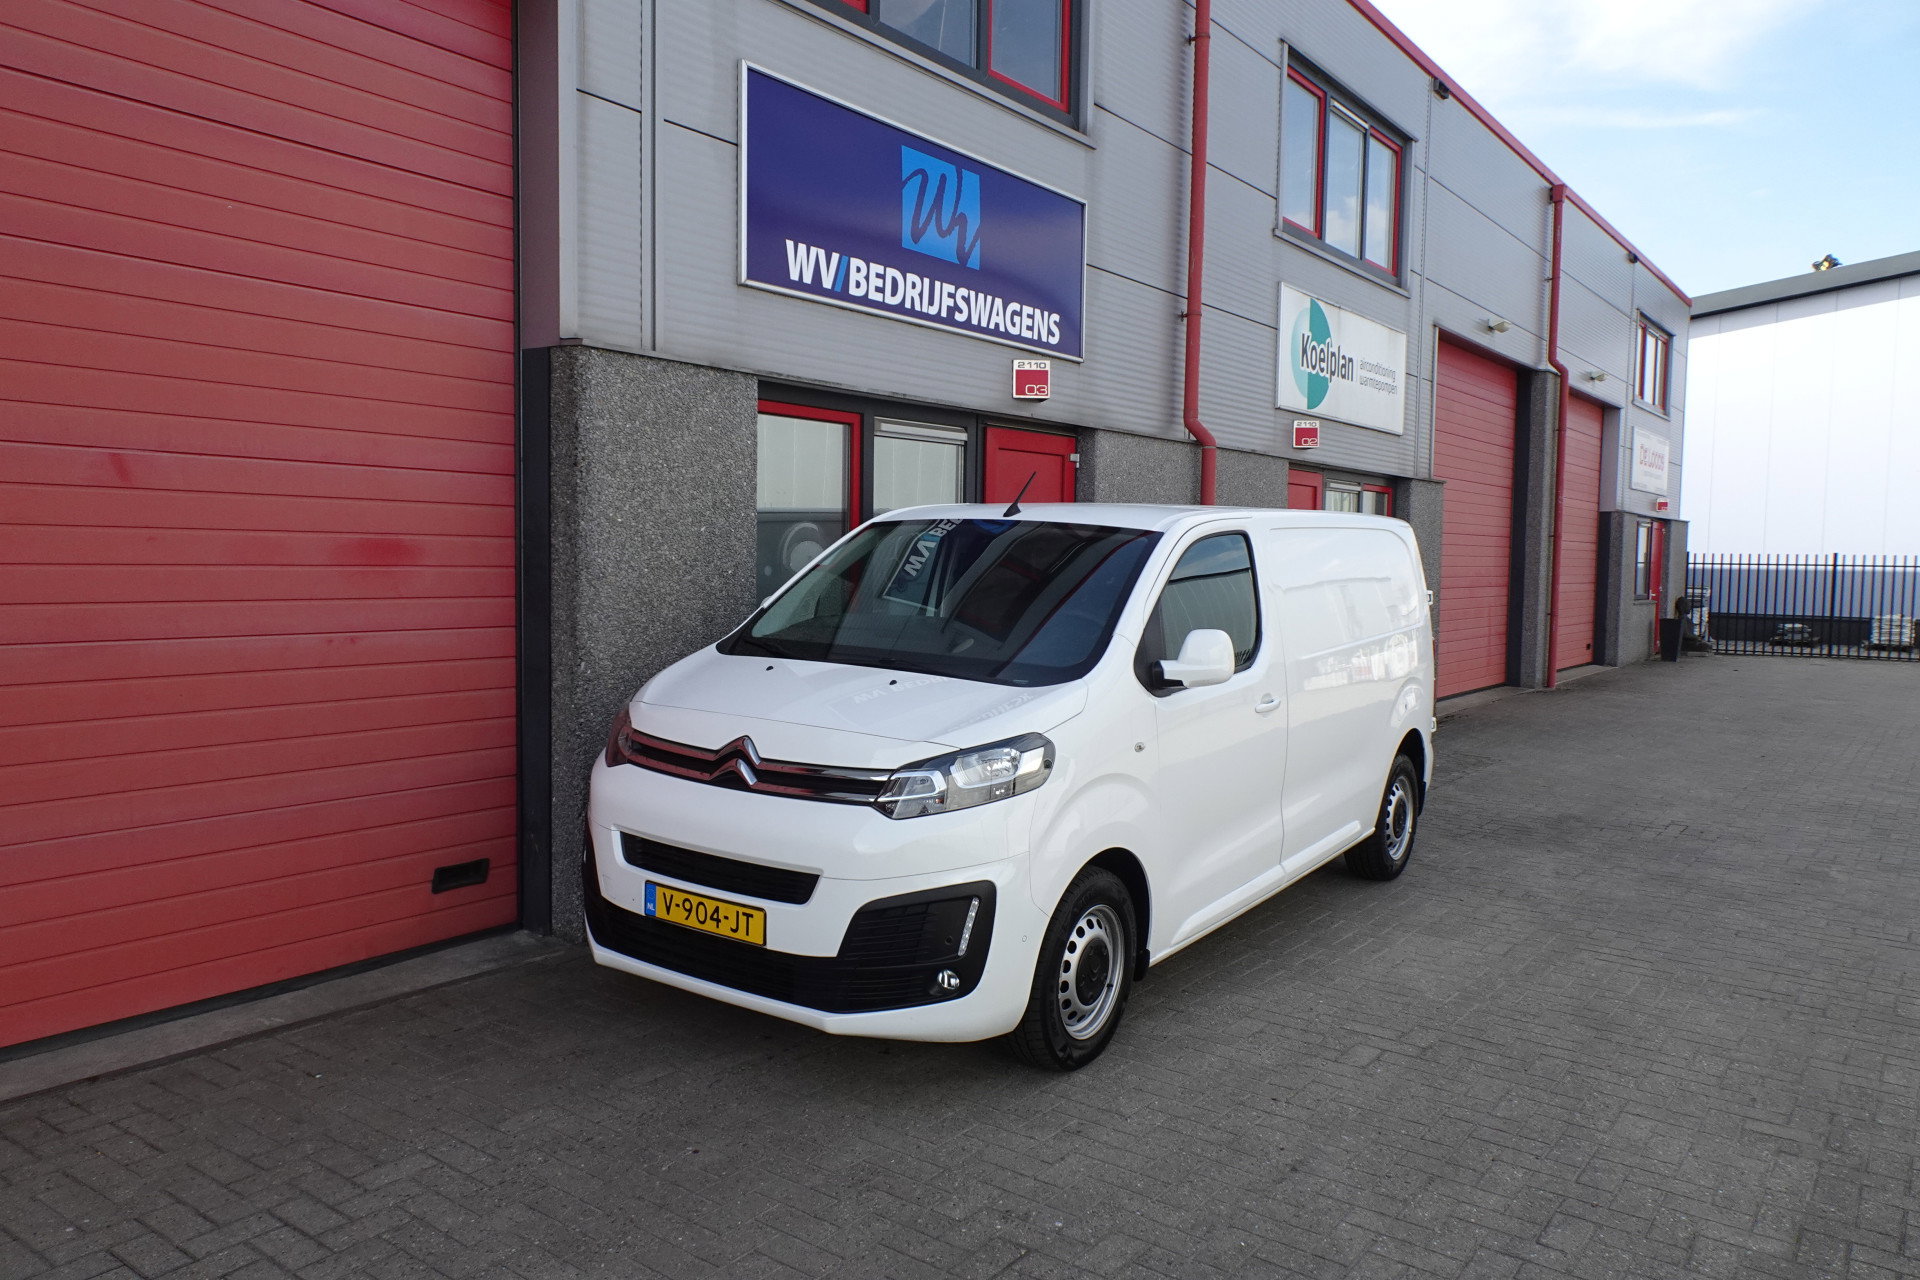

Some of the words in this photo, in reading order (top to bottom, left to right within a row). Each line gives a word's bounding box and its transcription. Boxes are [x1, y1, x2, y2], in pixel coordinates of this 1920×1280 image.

[1300, 333, 1354, 383] Koelplan
[1017, 361, 1047, 369] 2110
[1360, 359, 1396, 383] airconditioning
[1025, 384, 1048, 395] 03
[1302, 437, 1318, 446] 02
[647, 902, 655, 911] NL
[662, 891, 754, 937] V-904-JT
